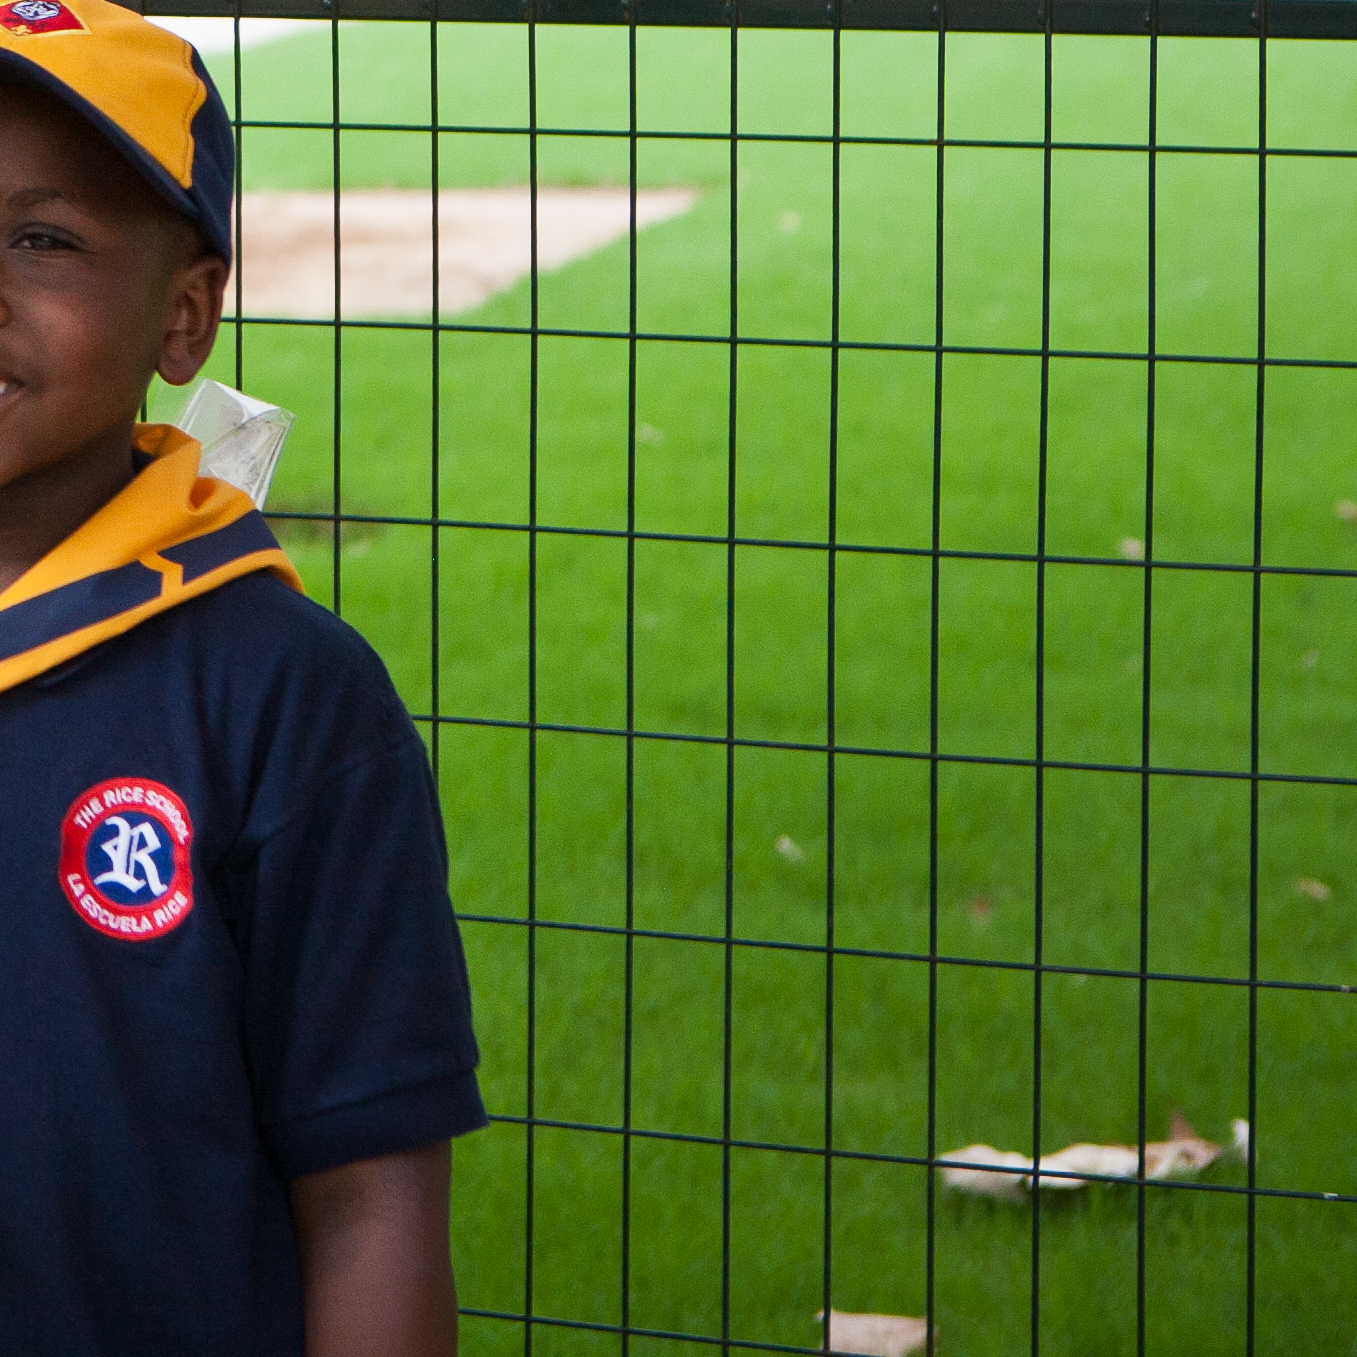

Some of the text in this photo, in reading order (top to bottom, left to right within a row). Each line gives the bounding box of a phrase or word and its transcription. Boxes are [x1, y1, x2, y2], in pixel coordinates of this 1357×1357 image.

[74, 786, 189, 844] THE RICE SCHOOL
[94, 816, 168, 897] R
[67, 873, 188, 933] LA ESCUELA RICE
